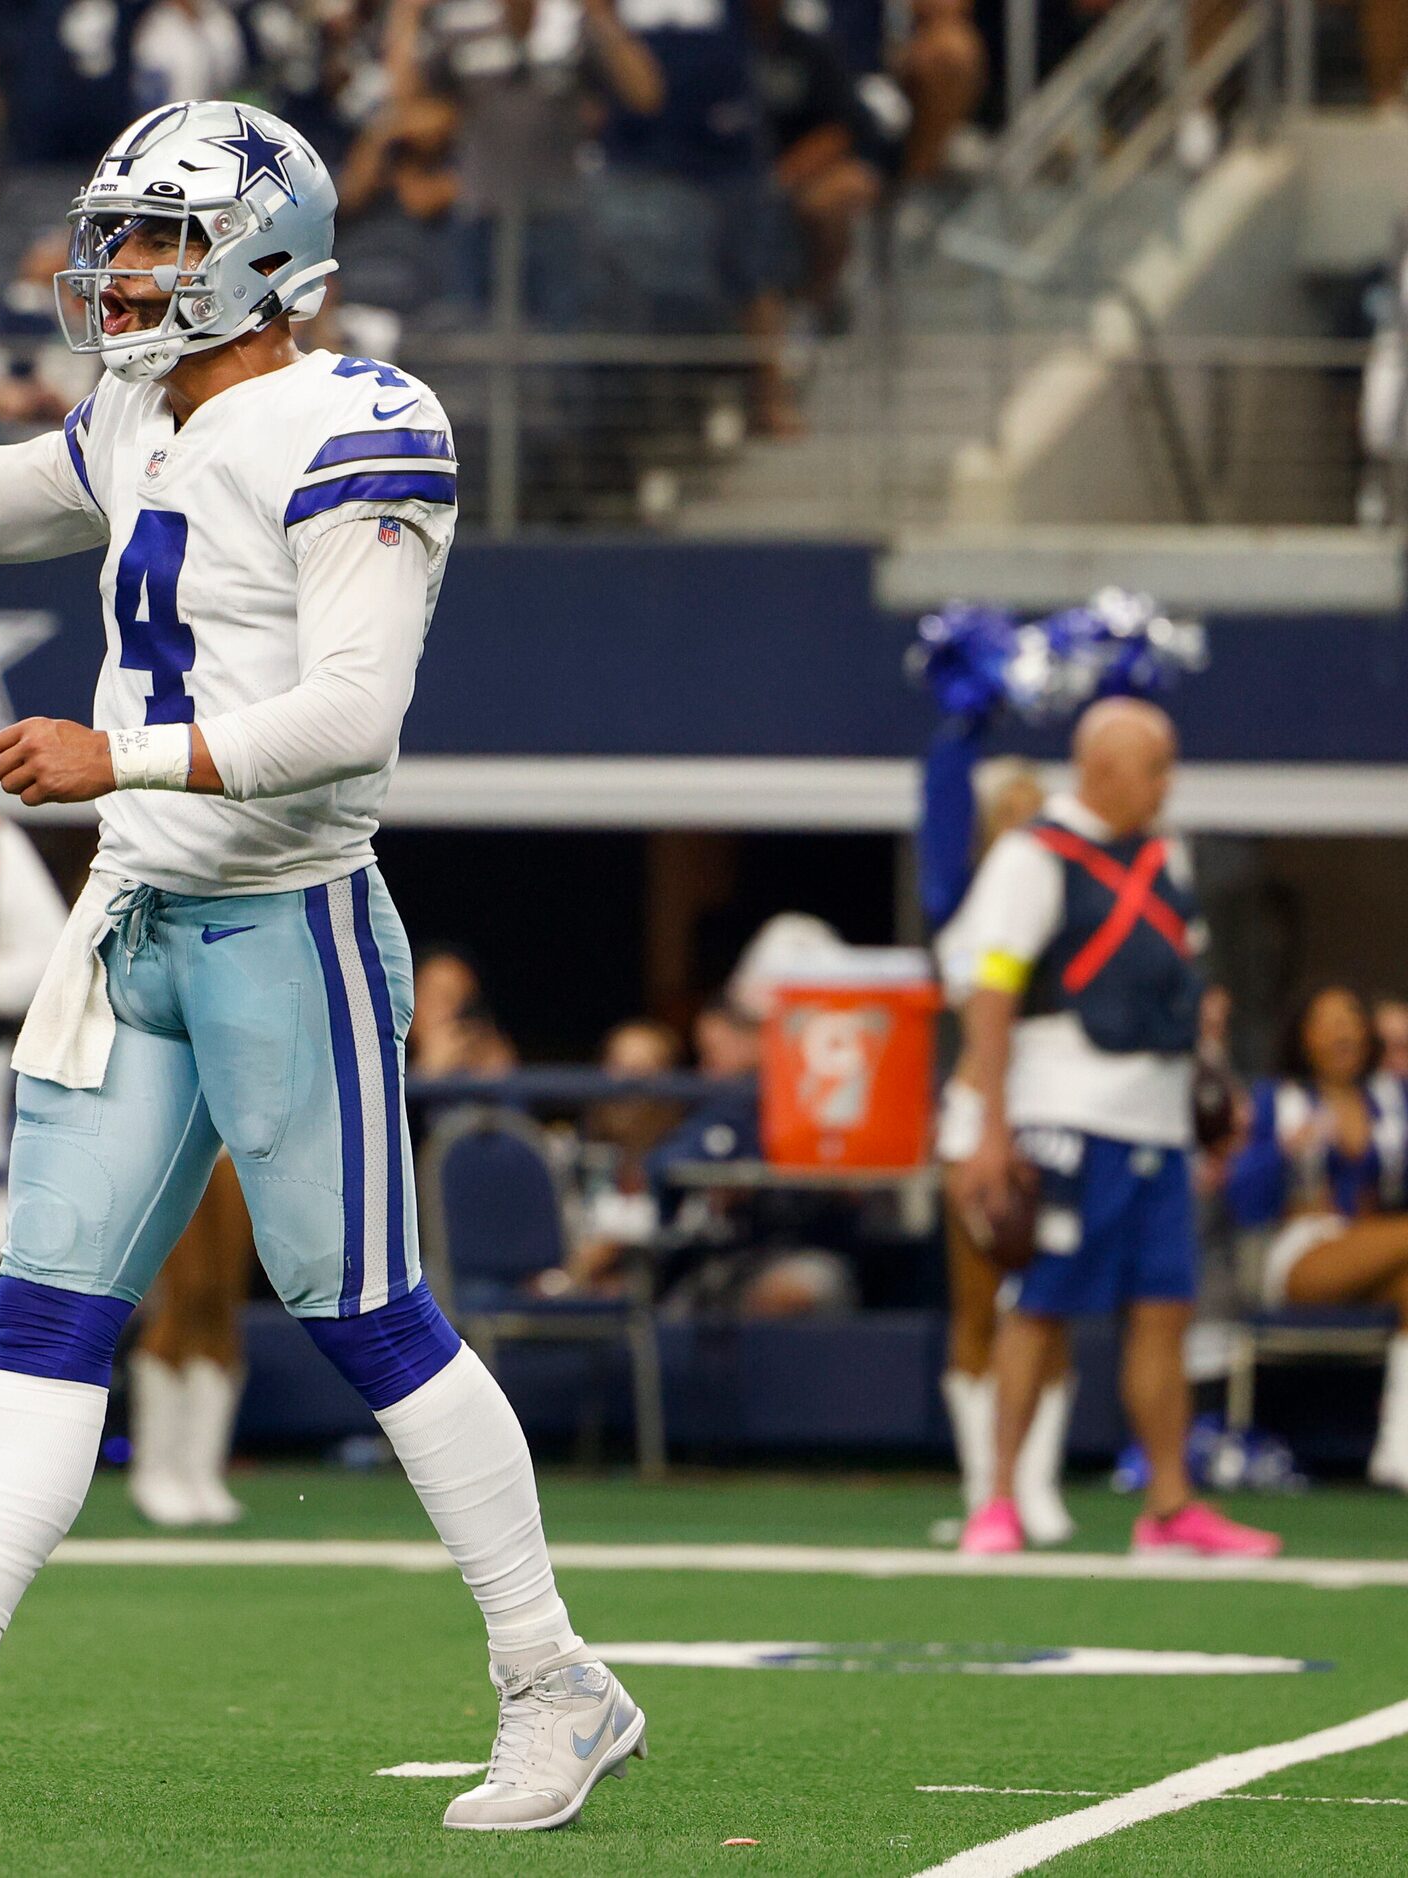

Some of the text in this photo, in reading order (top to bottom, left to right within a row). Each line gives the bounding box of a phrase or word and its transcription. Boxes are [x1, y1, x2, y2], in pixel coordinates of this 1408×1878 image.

[331, 357, 410, 387] 4
[380, 527, 398, 544] NFL
[114, 509, 196, 726] 4
